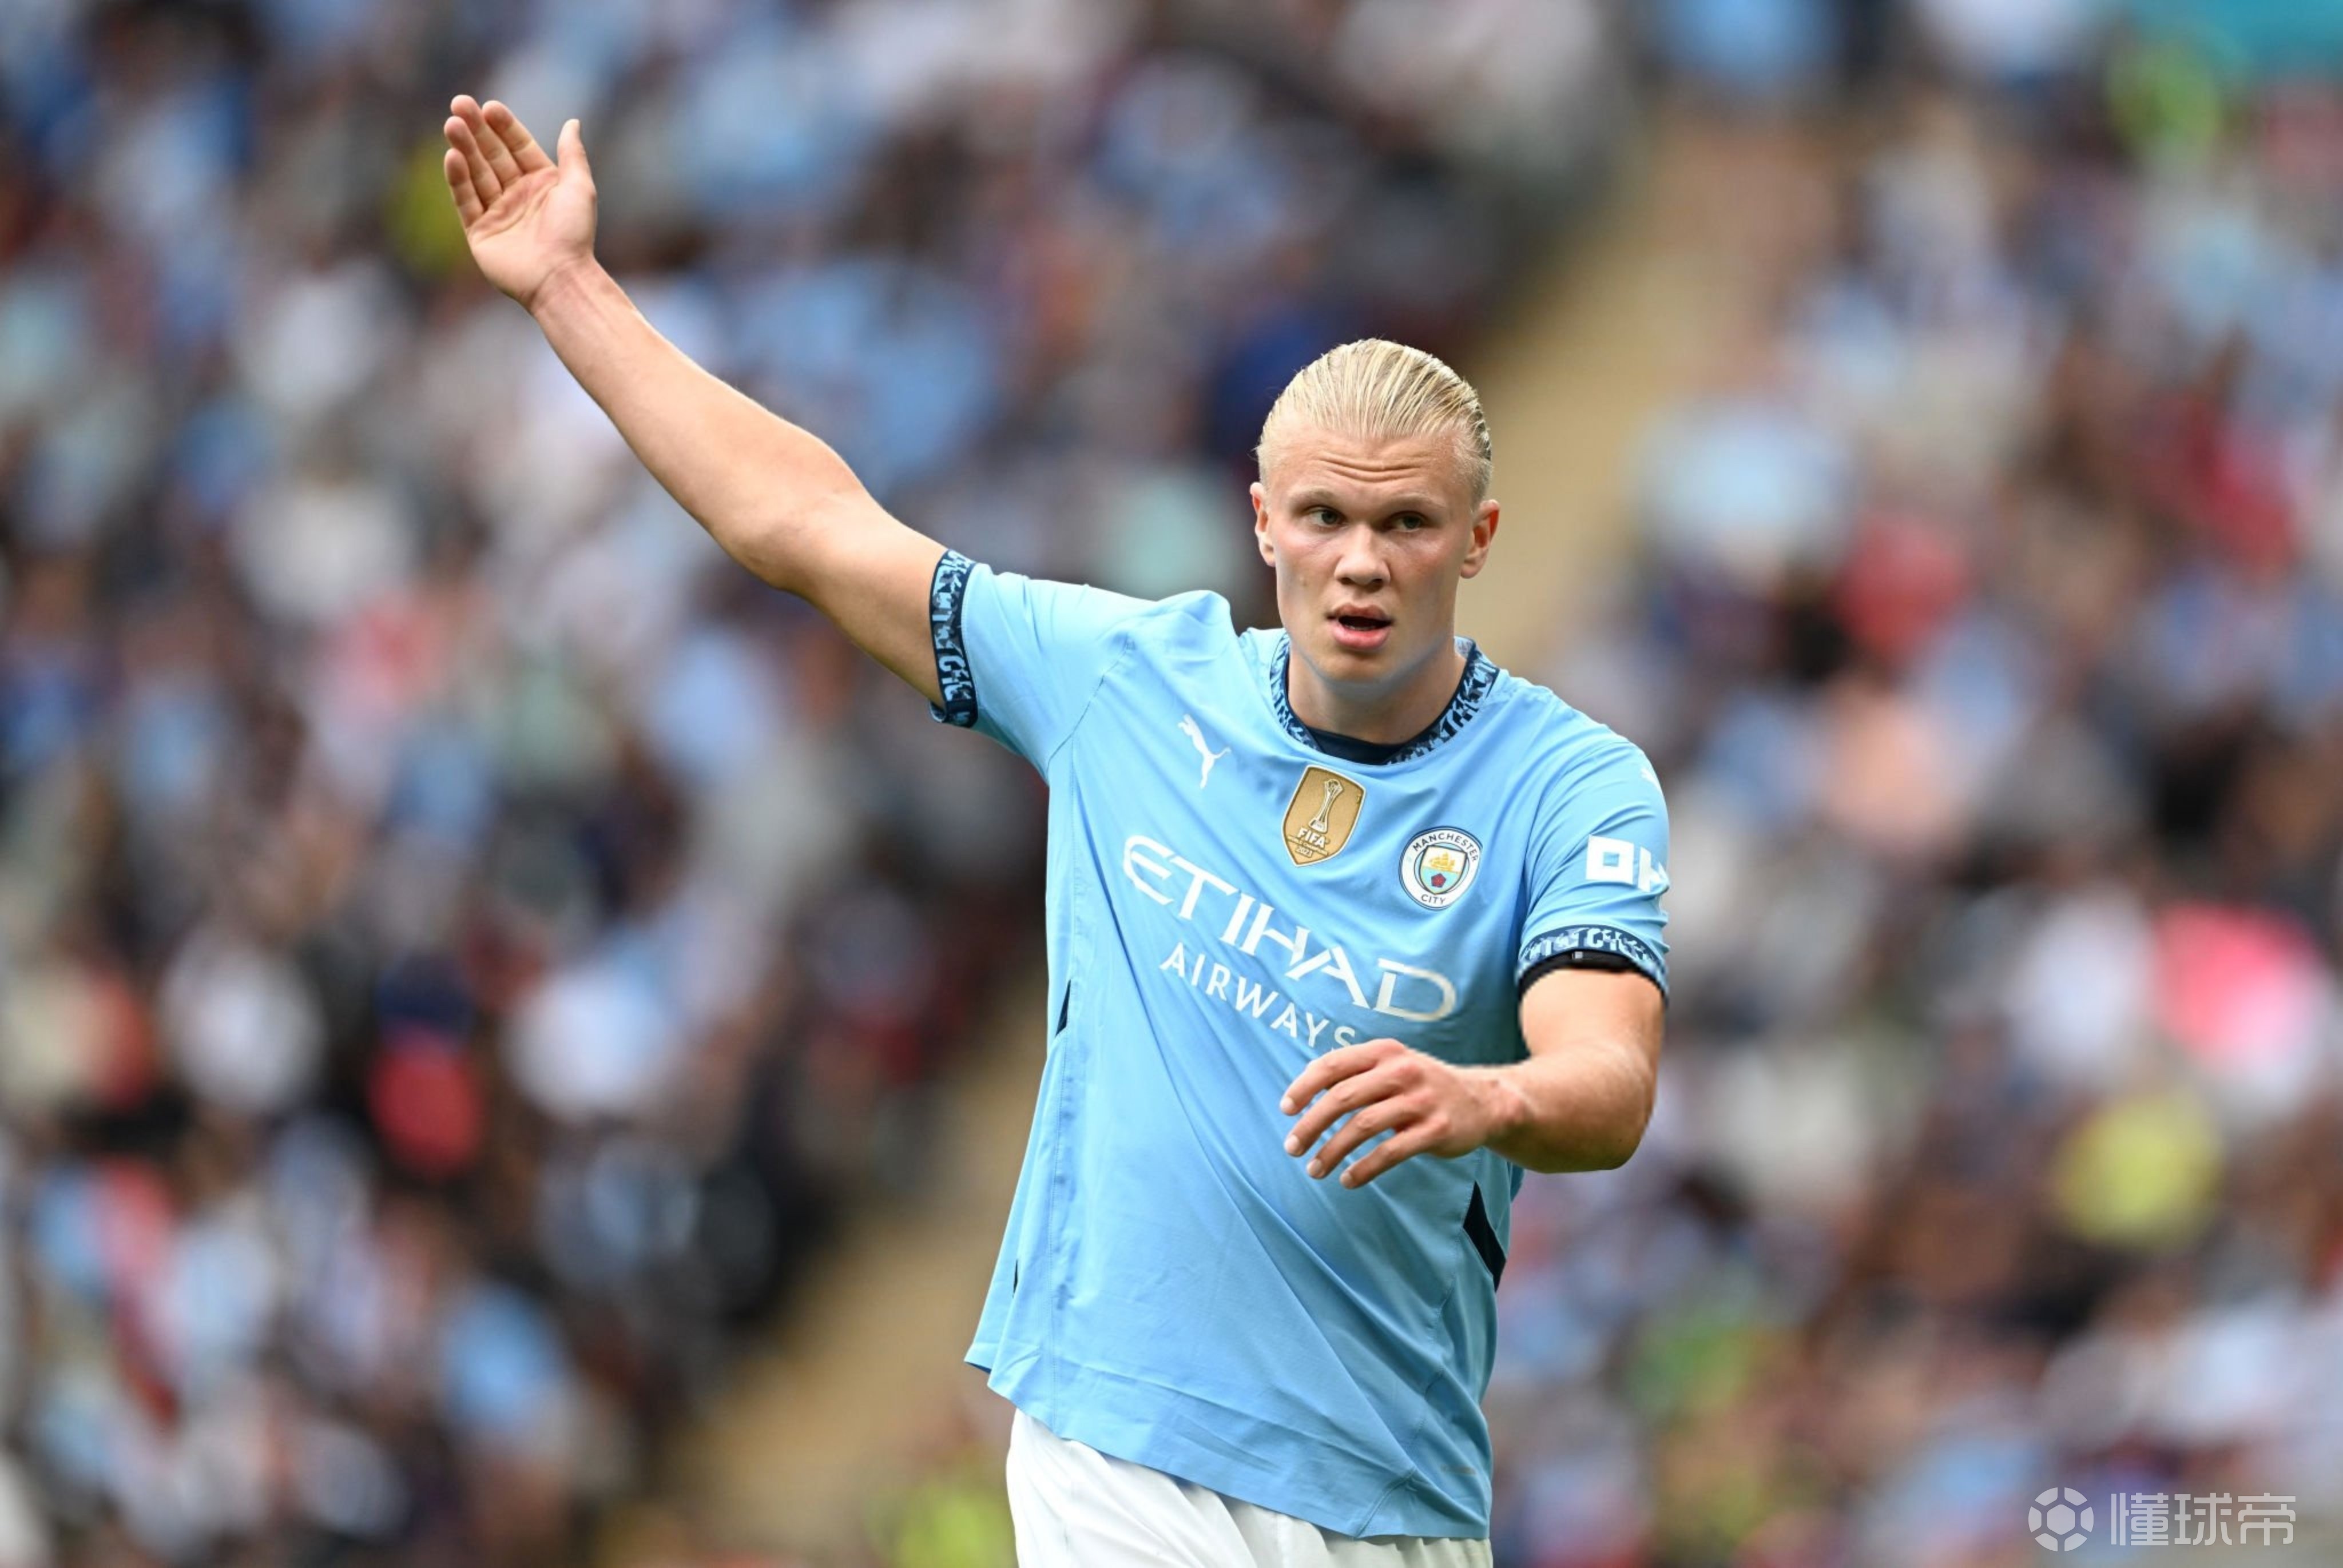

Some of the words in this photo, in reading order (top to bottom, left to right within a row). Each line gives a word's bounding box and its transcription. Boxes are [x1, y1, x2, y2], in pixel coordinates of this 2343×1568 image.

[1297, 827, 1326, 849] FIFA
[1412, 832, 1479, 862] MANCHESTER
[1420, 893, 1447, 905] CITY
[1123, 834, 1457, 1022] ETIHAD
